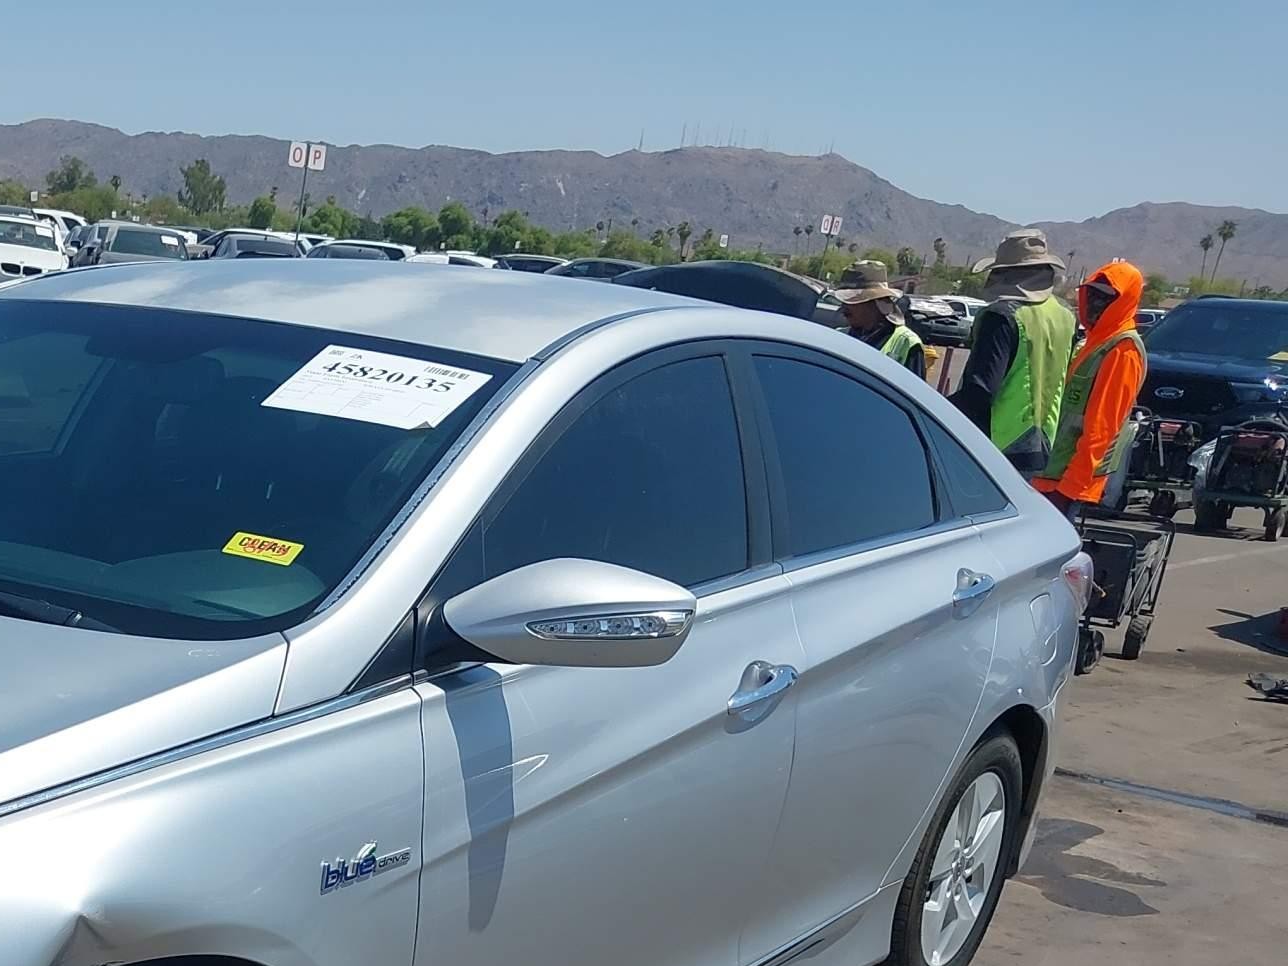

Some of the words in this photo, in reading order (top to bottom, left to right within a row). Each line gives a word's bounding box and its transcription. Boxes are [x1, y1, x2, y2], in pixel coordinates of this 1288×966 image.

[313, 150, 322, 165] P
[323, 361, 456, 393] 45820135
[320, 855, 376, 892] blue
[378, 852, 410, 868] drive
